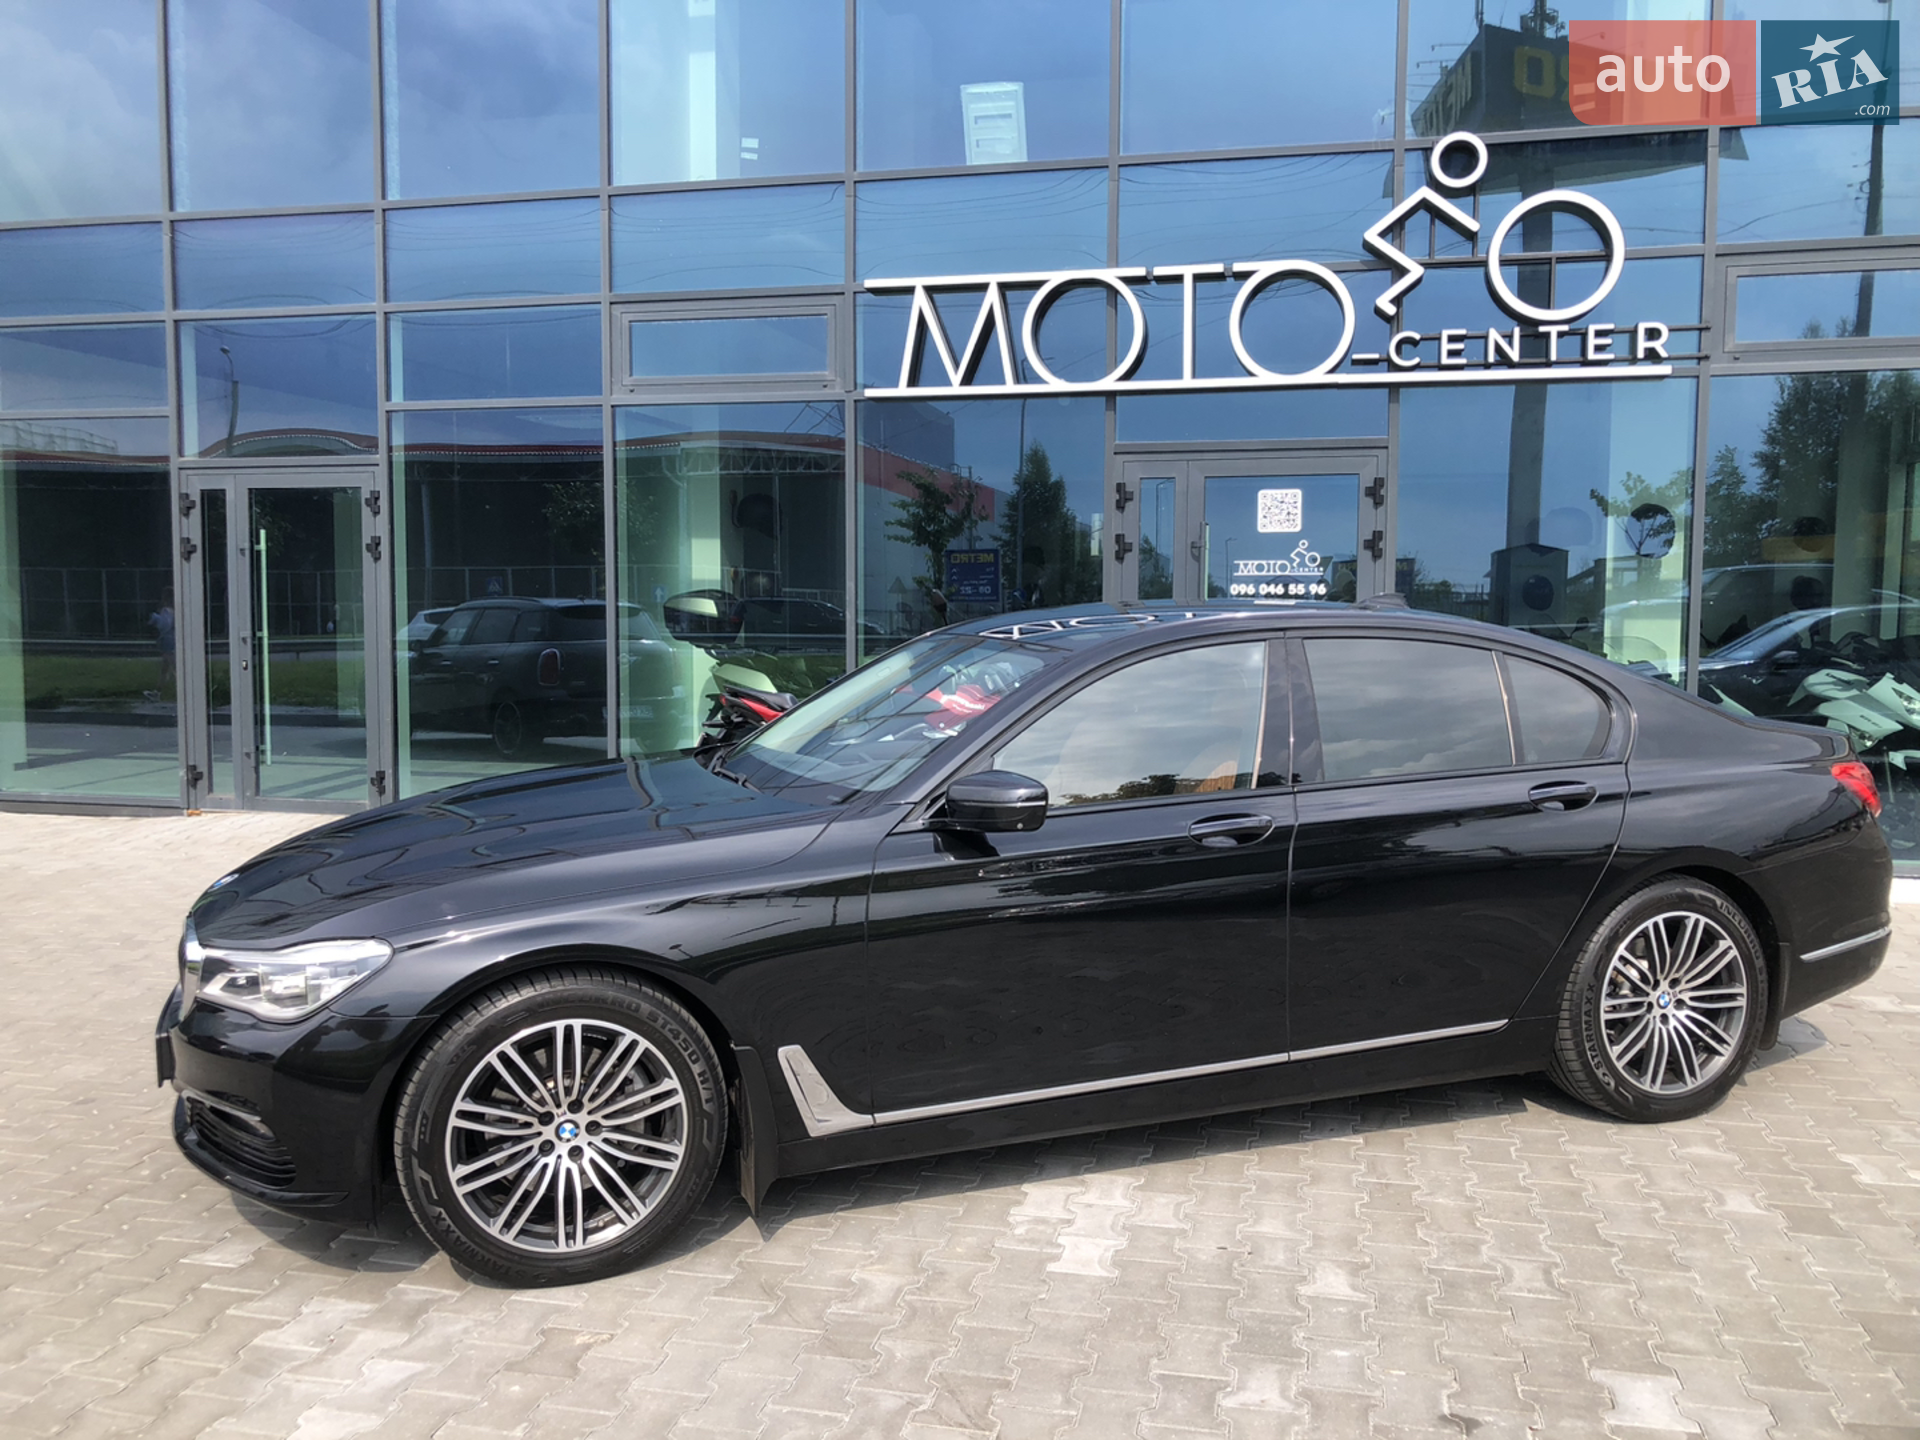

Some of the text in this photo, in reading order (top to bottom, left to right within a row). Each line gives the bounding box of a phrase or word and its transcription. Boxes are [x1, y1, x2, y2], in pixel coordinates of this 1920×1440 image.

[890, 259, 1357, 393] MOTO
[1388, 321, 1669, 368] CENTER
[1230, 583, 1327, 595] 096 046 55 96
[1237, 560, 1291, 575] MOTO
[646, 1010, 701, 1065] ST450
[1584, 982, 1603, 1071] STARMAXX
[430, 1209, 529, 1280] STARMAXX
